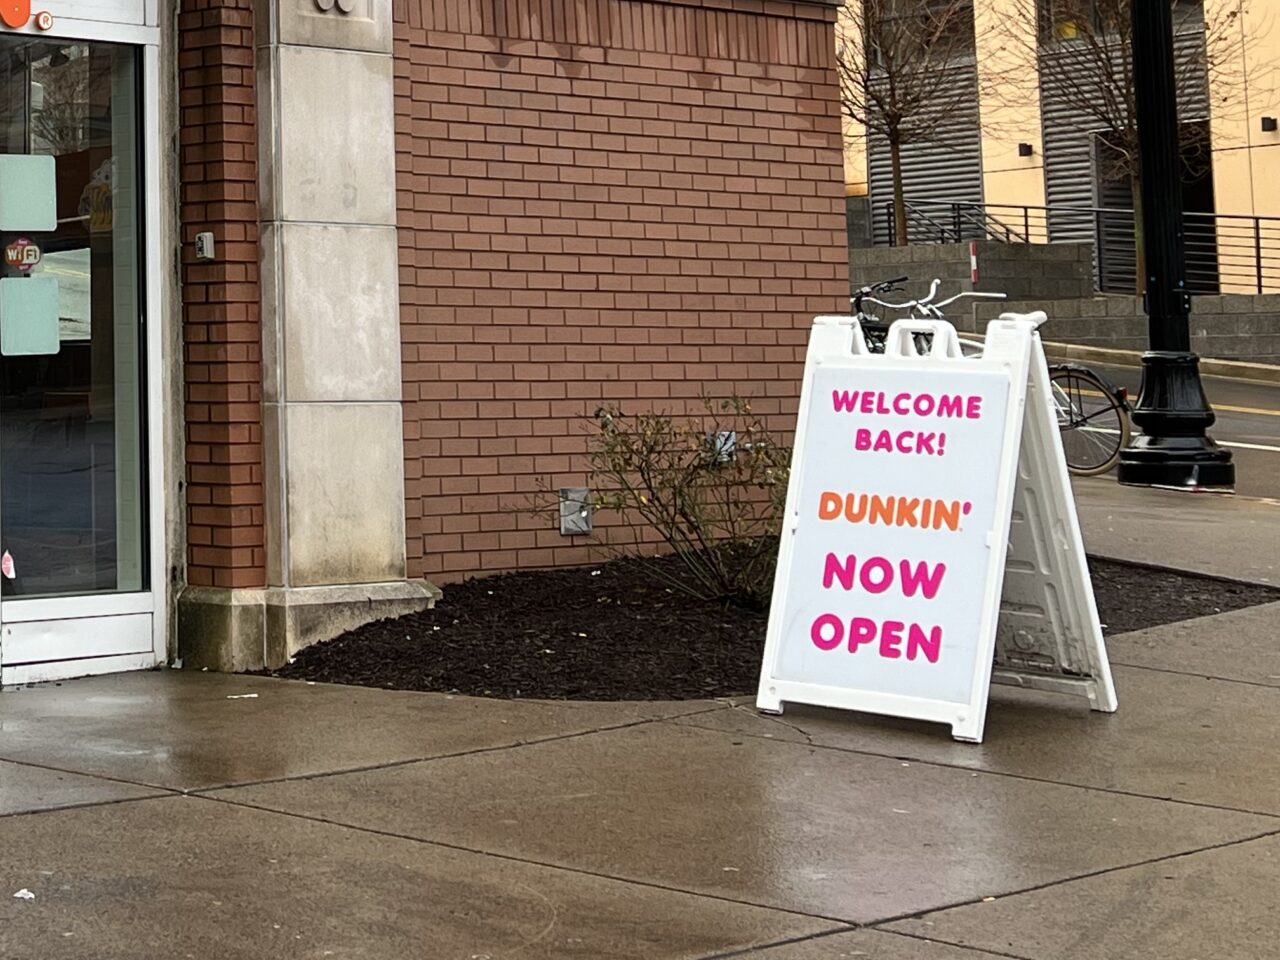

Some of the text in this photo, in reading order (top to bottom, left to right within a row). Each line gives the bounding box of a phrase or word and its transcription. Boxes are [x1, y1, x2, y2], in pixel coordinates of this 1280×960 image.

[832, 390, 983, 419] WELCOME
[855, 428, 946, 456] BACK!
[818, 491, 973, 531] DUNKIN'
[822, 552, 946, 600] NOW
[810, 613, 943, 664] OPEN
